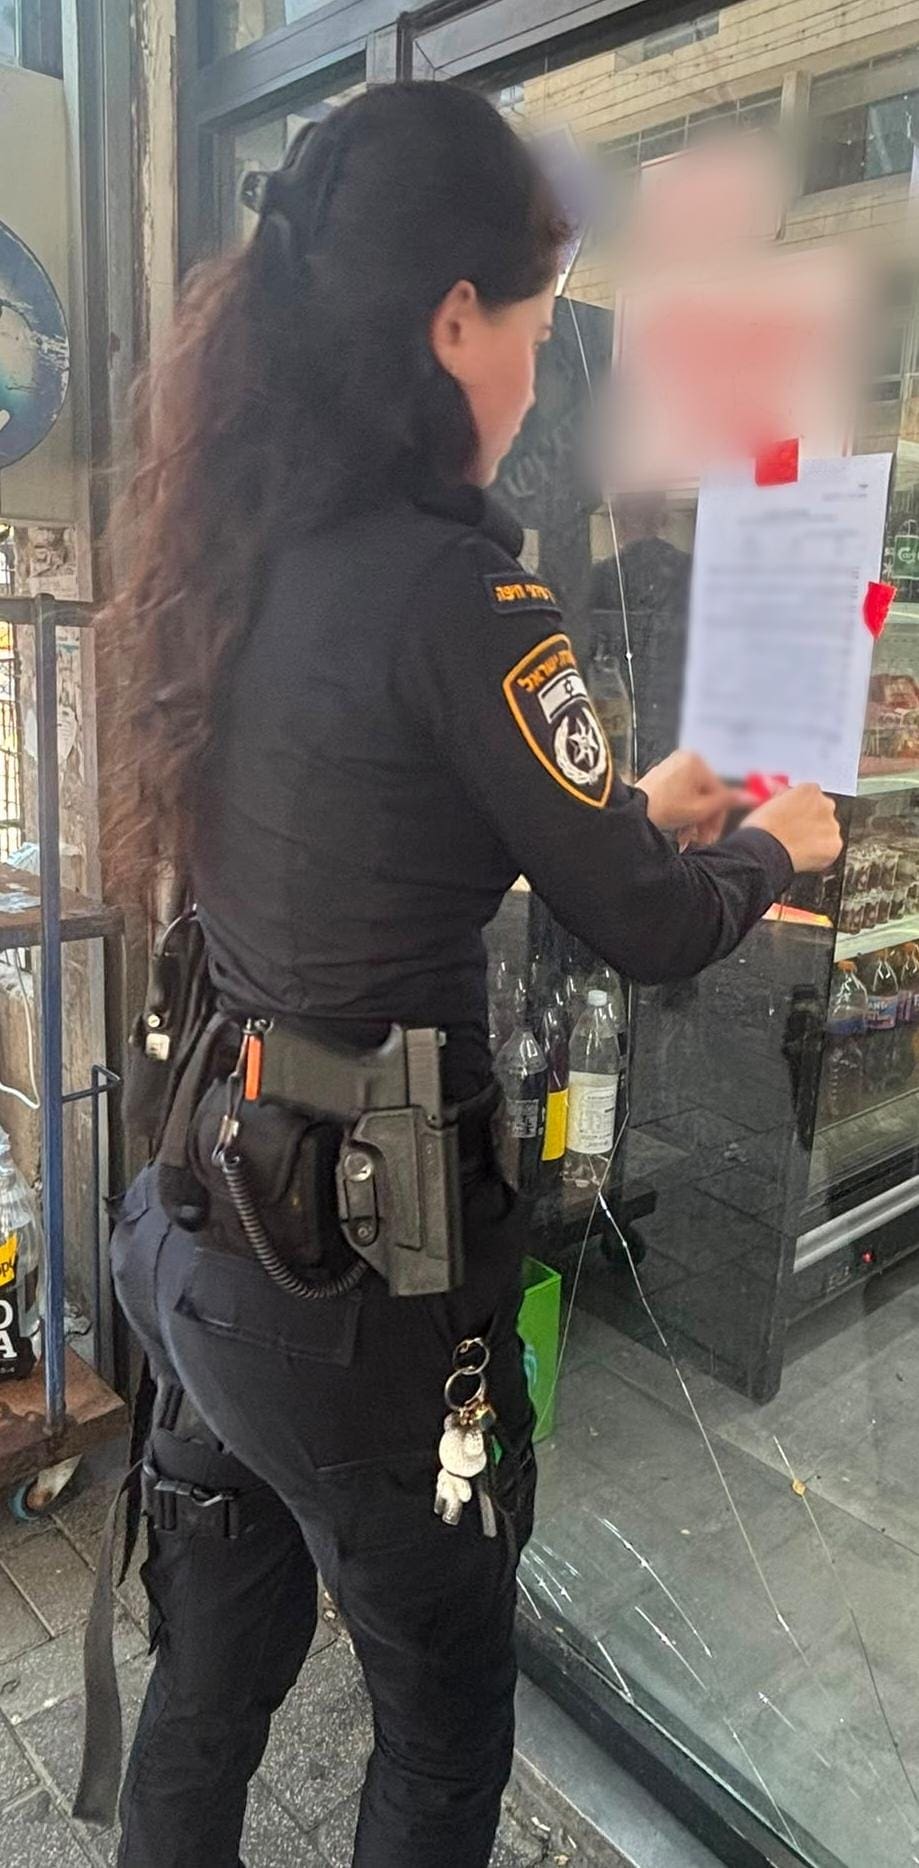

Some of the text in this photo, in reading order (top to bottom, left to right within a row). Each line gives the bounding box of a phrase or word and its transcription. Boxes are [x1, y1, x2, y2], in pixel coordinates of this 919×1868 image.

[494, 584, 525, 602] חיפה
[517, 653, 559, 693] ישראל
[0, 1299, 14, 1330] O
[0, 1330, 18, 1359] A
